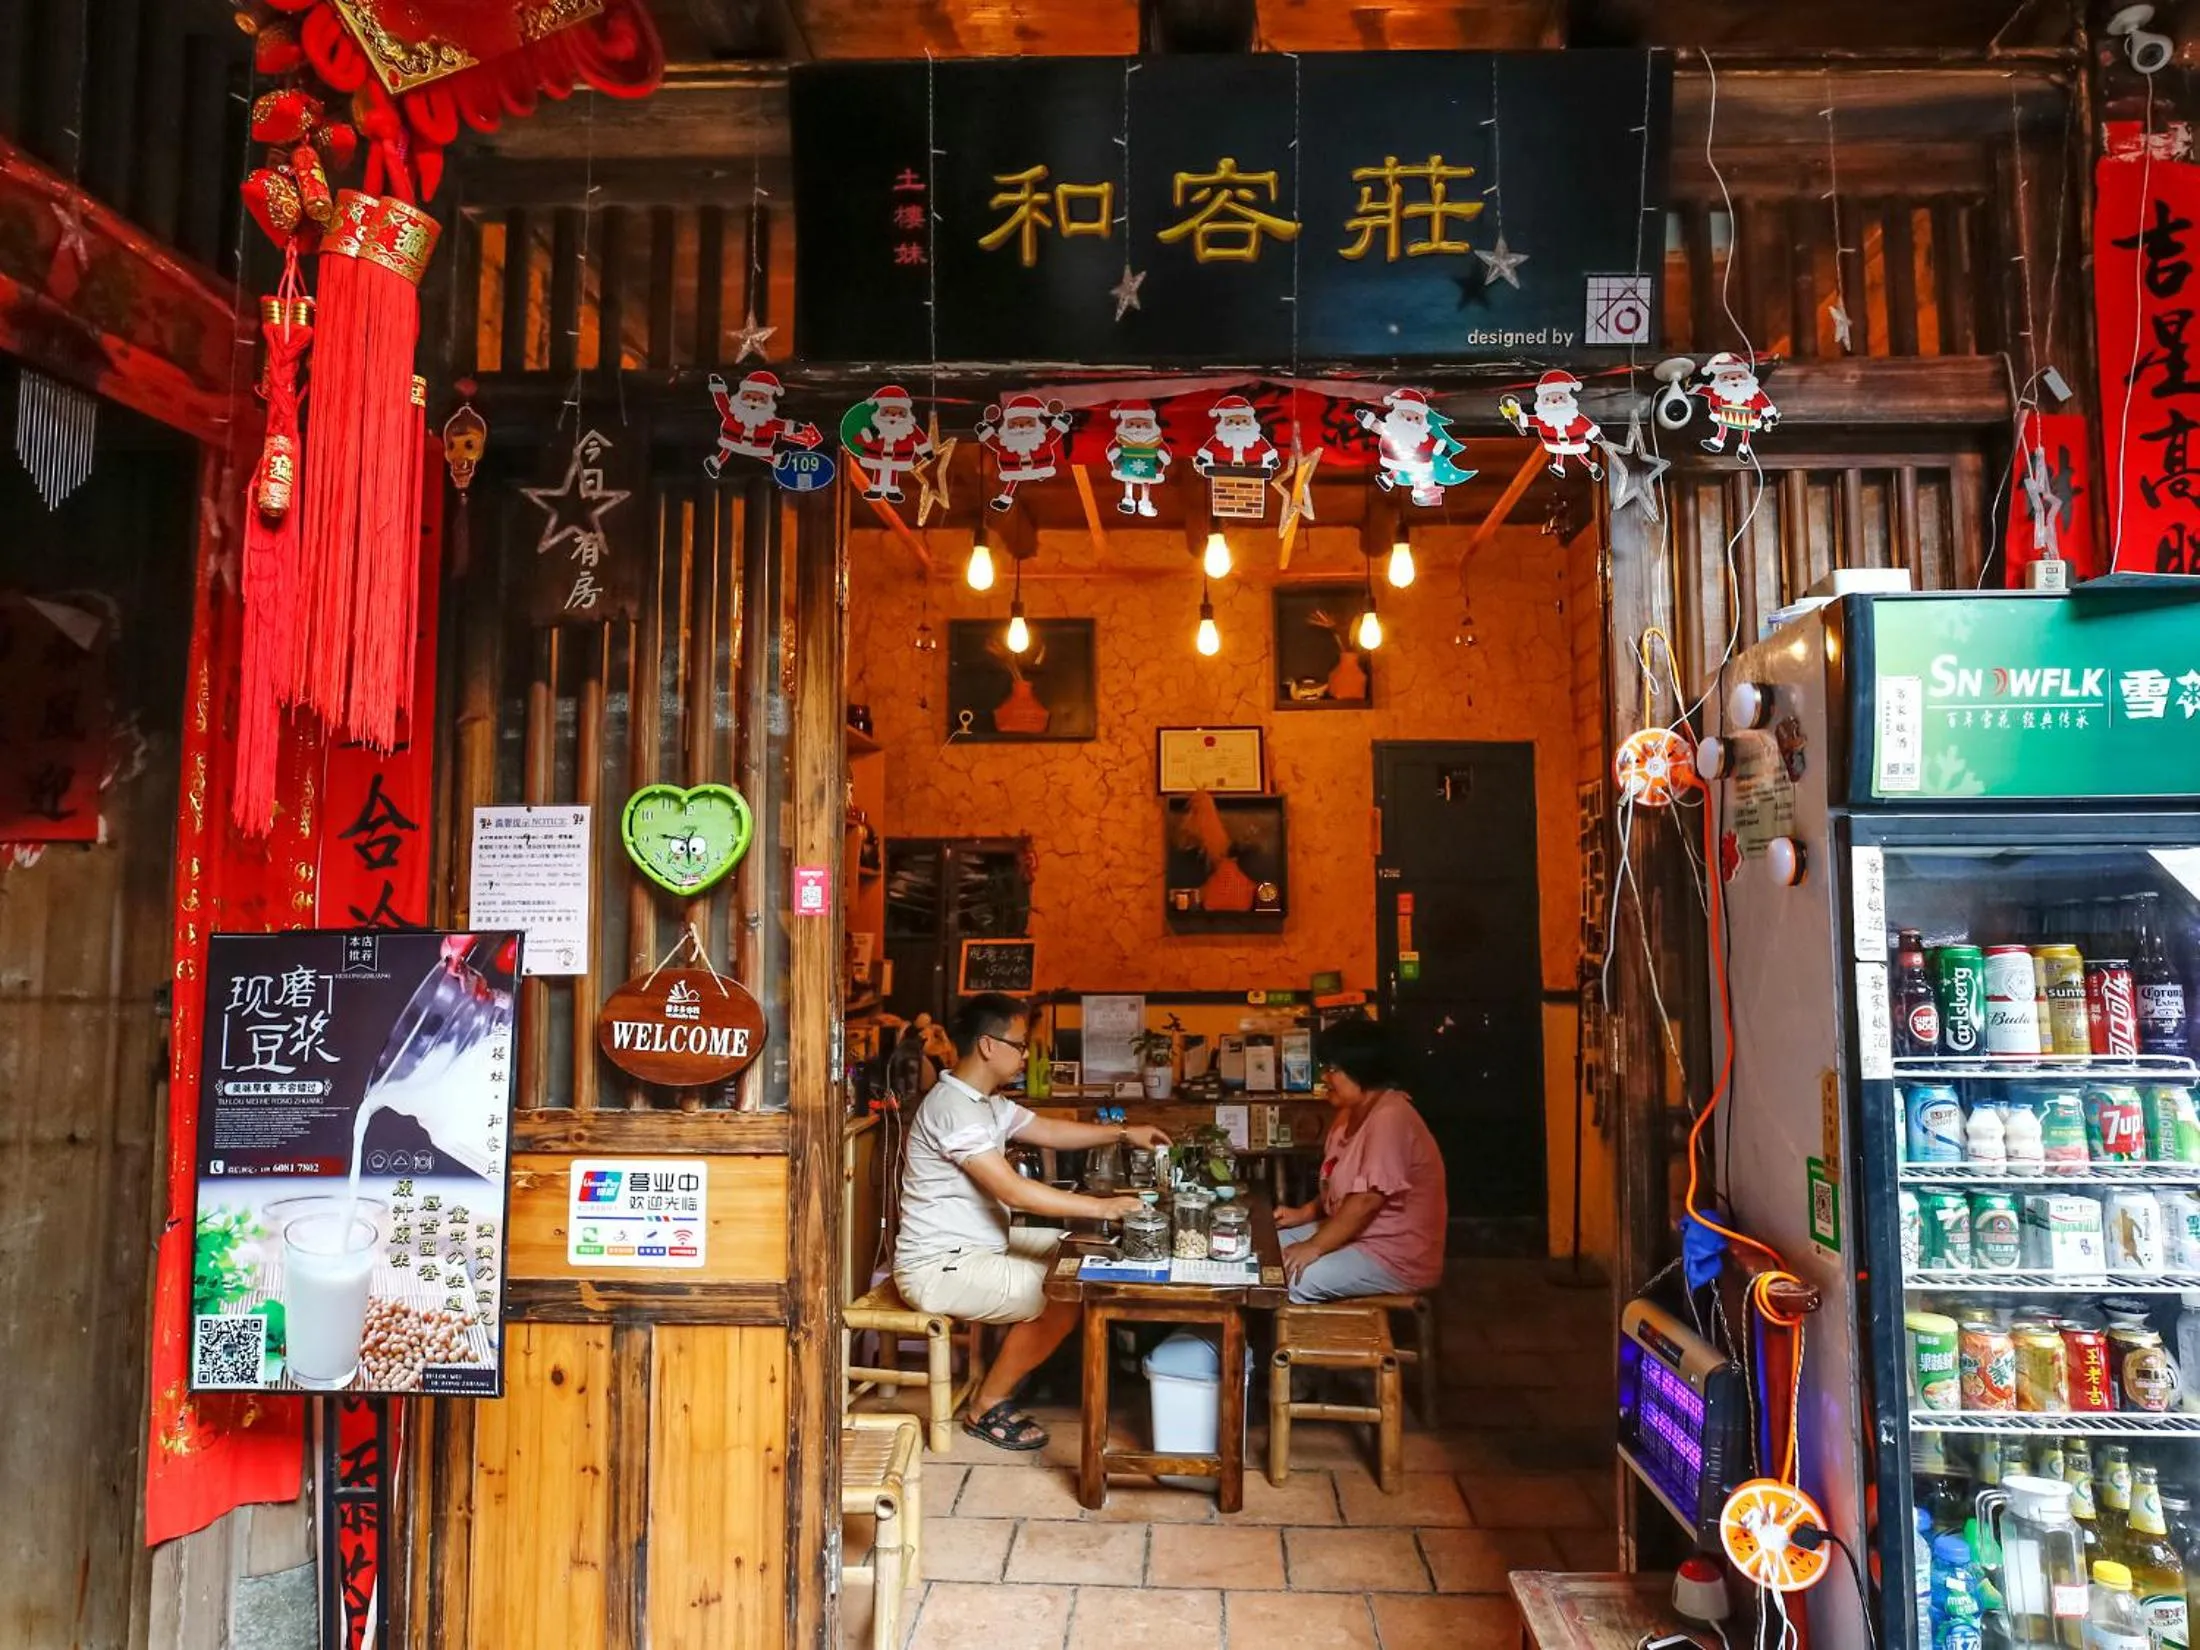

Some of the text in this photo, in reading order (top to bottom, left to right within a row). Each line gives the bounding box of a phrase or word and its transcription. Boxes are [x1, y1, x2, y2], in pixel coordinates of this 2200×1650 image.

[892, 167, 928, 265] 土樓妹
[977, 155, 1486, 268] 和容莊
[1467, 328, 1574, 347] designed by
[790, 456, 820, 472] 109
[224, 964, 318, 1018] 现磨
[2048, 988, 2087, 998] sunto
[236, 1009, 341, 1074] 豆浆
[612, 1020, 751, 1058] WELCOME
[629, 1172, 699, 1192] 营业中
[629, 1195, 698, 1211] 欢迎光临
[2085, 1347, 2102, 1406] 王老吉
